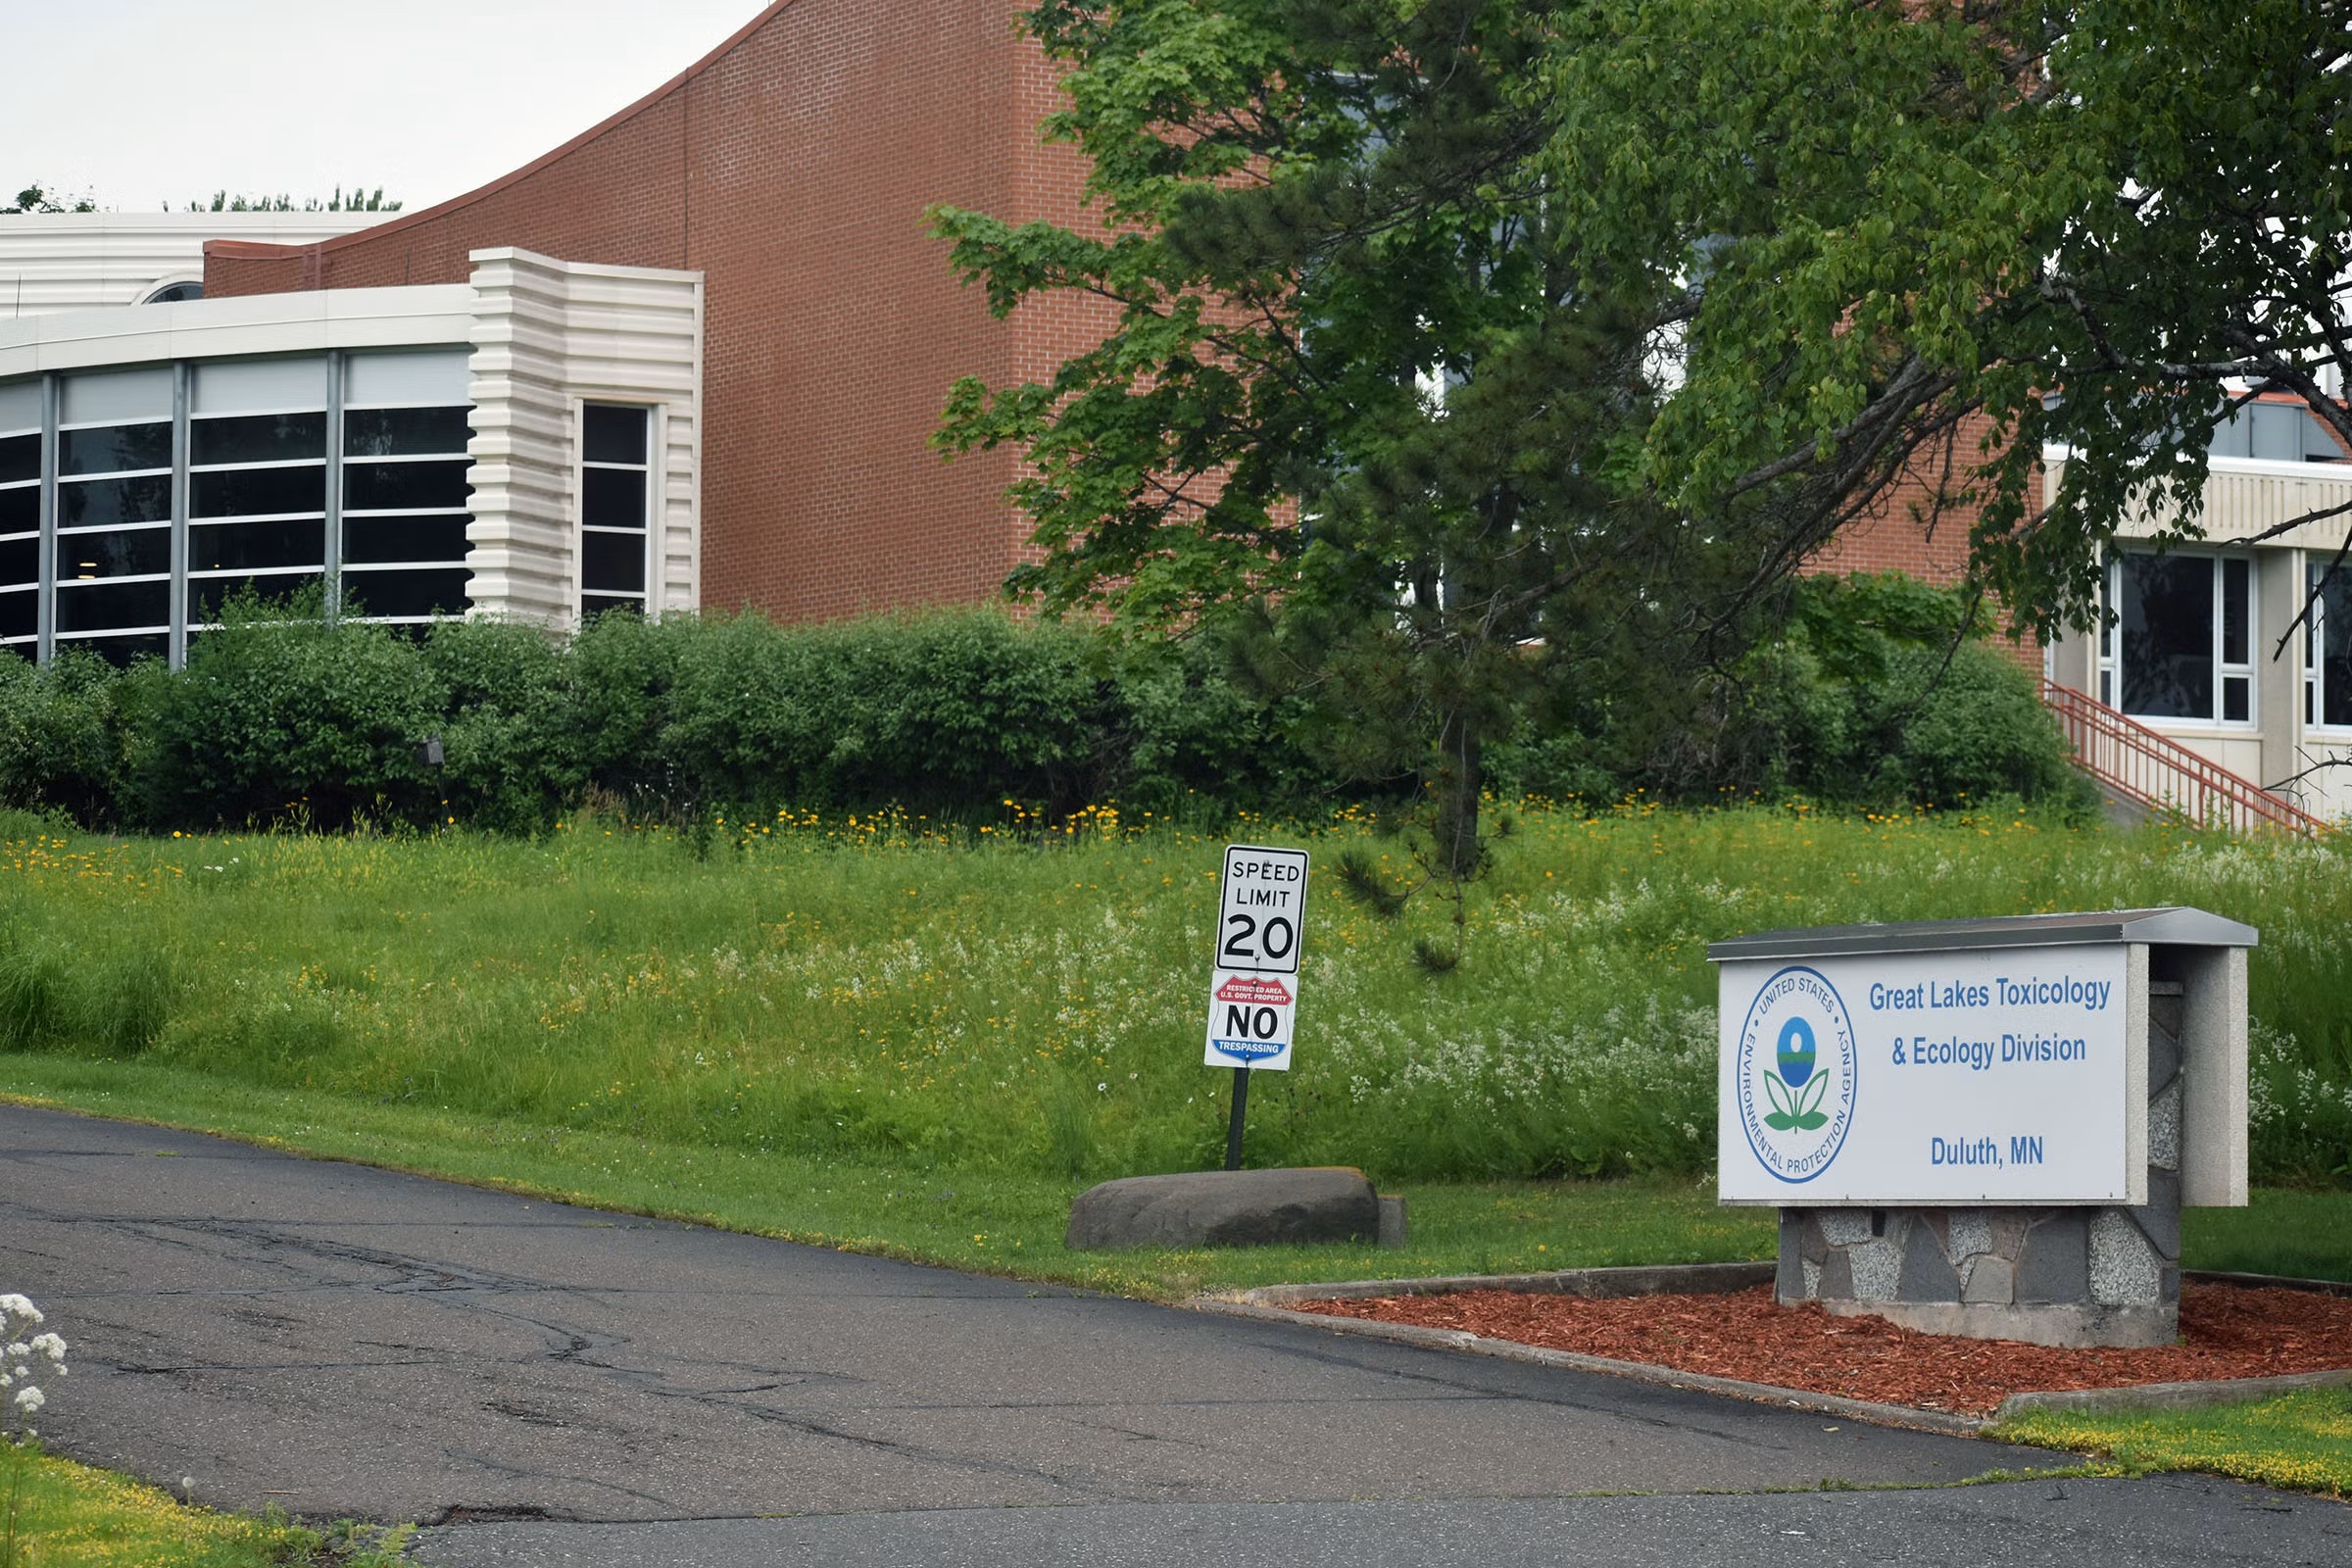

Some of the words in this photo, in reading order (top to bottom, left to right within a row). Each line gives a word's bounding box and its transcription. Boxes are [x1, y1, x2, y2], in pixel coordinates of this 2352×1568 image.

[1232, 860, 1299, 882] SPEED
[1236, 887, 1291, 907] LIMIT
[1224, 913, 1294, 959] 20
[1253, 994, 1288, 1003] PROPERTY
[1758, 978, 1795, 1015] UNITED
[1798, 977, 1835, 1013] STATES
[1869, 982, 1924, 1010] Great
[1931, 980, 1989, 1008] Lakes
[1995, 975, 2111, 1010] Toxicology
[1225, 1004, 1278, 1040] NO
[1218, 1041, 1279, 1054] TRESPASSING
[1891, 1037, 1907, 1065] &
[1913, 1036, 1995, 1071] Ecology
[2001, 1033, 2086, 1062] Division
[1742, 1033, 1783, 1170] ENVIRONMENTAL
[1787, 1109, 1846, 1173] PROTECTION
[1837, 1030, 1851, 1105] AGENCY
[1931, 1137, 2003, 1170] Duluth,
[2010, 1136, 2043, 1165] MN
